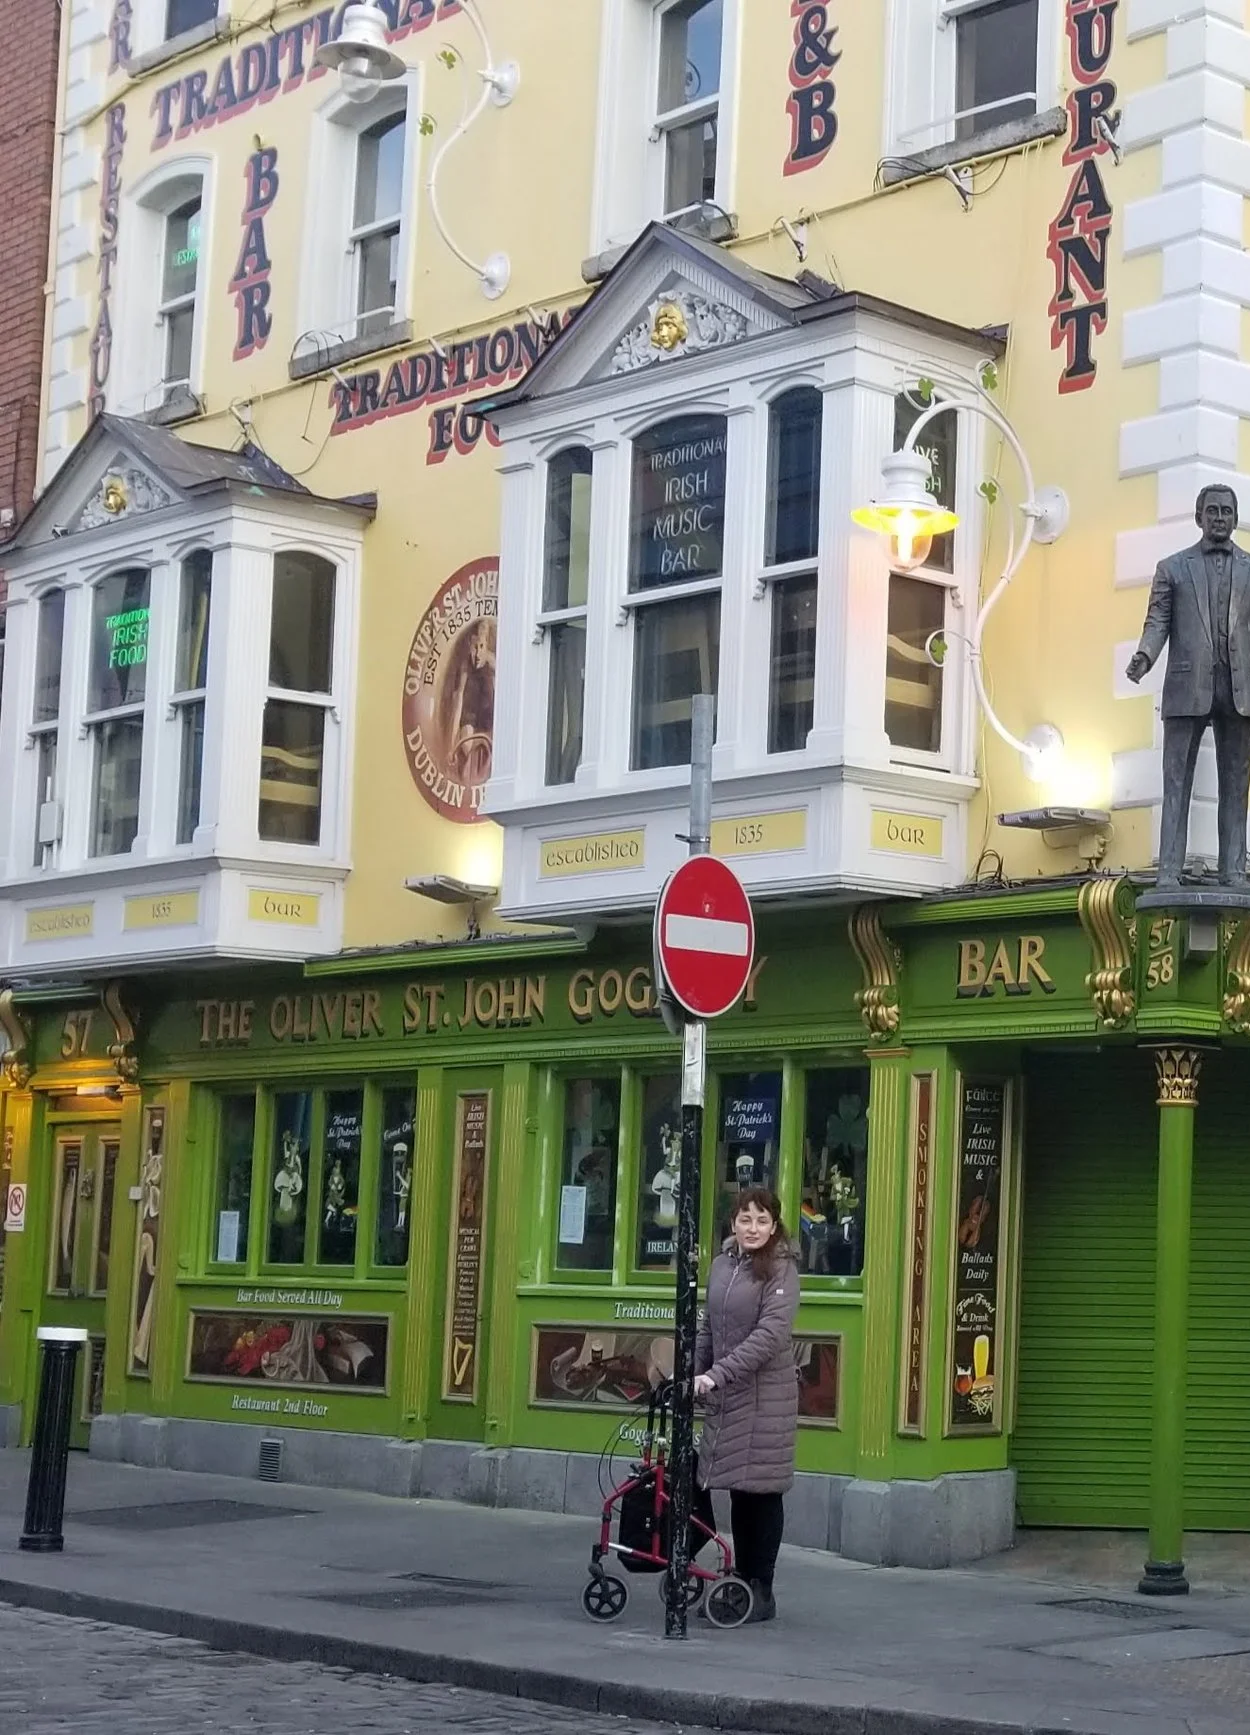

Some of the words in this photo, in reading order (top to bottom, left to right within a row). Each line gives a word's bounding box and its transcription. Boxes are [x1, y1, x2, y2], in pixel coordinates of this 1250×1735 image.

[1048, 0, 1120, 394] URANT
[228, 146, 279, 362] BAR
[664, 469, 709, 503] IRISH
[653, 504, 716, 541] MUSIC
[661, 543, 701, 575] BAR
[466, 570, 499, 600] JOH
[112, 622, 148, 647] IRISH
[424, 643, 440, 686] EST
[441, 605, 472, 643] 1835
[109, 644, 147, 668] FOOD
[407, 726, 466, 809] DUBLIN
[734, 823, 764, 846] 1835
[1148, 918, 1174, 950] 57
[957, 935, 1056, 999] BAR
[1146, 954, 1174, 991] 58
[199, 999, 256, 1048] THE
[269, 989, 385, 1042] OLIVER
[402, 982, 451, 1034] ST.
[457, 975, 548, 1029] JOHN
[568, 955, 768, 1023] GOGY
[61, 1009, 94, 1060] 57
[732, 1100, 763, 1114] Happy
[737, 1127, 756, 1140] Day
[973, 1123, 992, 1134] Live
[967, 1138, 996, 1151] IRISH
[964, 1154, 997, 1167] MUSIC
[976, 1169, 983, 1180] &
[914, 1123, 928, 1276] SMOKING
[647, 1242, 679, 1254] IRELAN
[962, 1253, 993, 1264] Ballads
[966, 1269, 989, 1282] Daily
[237, 1289, 253, 1302] Bar
[253, 1289, 275, 1303] Food
[277, 1290, 305, 1304] Served
[305, 1290, 321, 1305] All
[323, 1291, 342, 1309] Day
[614, 1302, 675, 1319] Traditiona
[911, 1305, 922, 1391] AREA
[232, 1395, 280, 1412] Restaurant
[283, 1398, 300, 1413] 2nd
[303, 1400, 328, 1415] Floor
